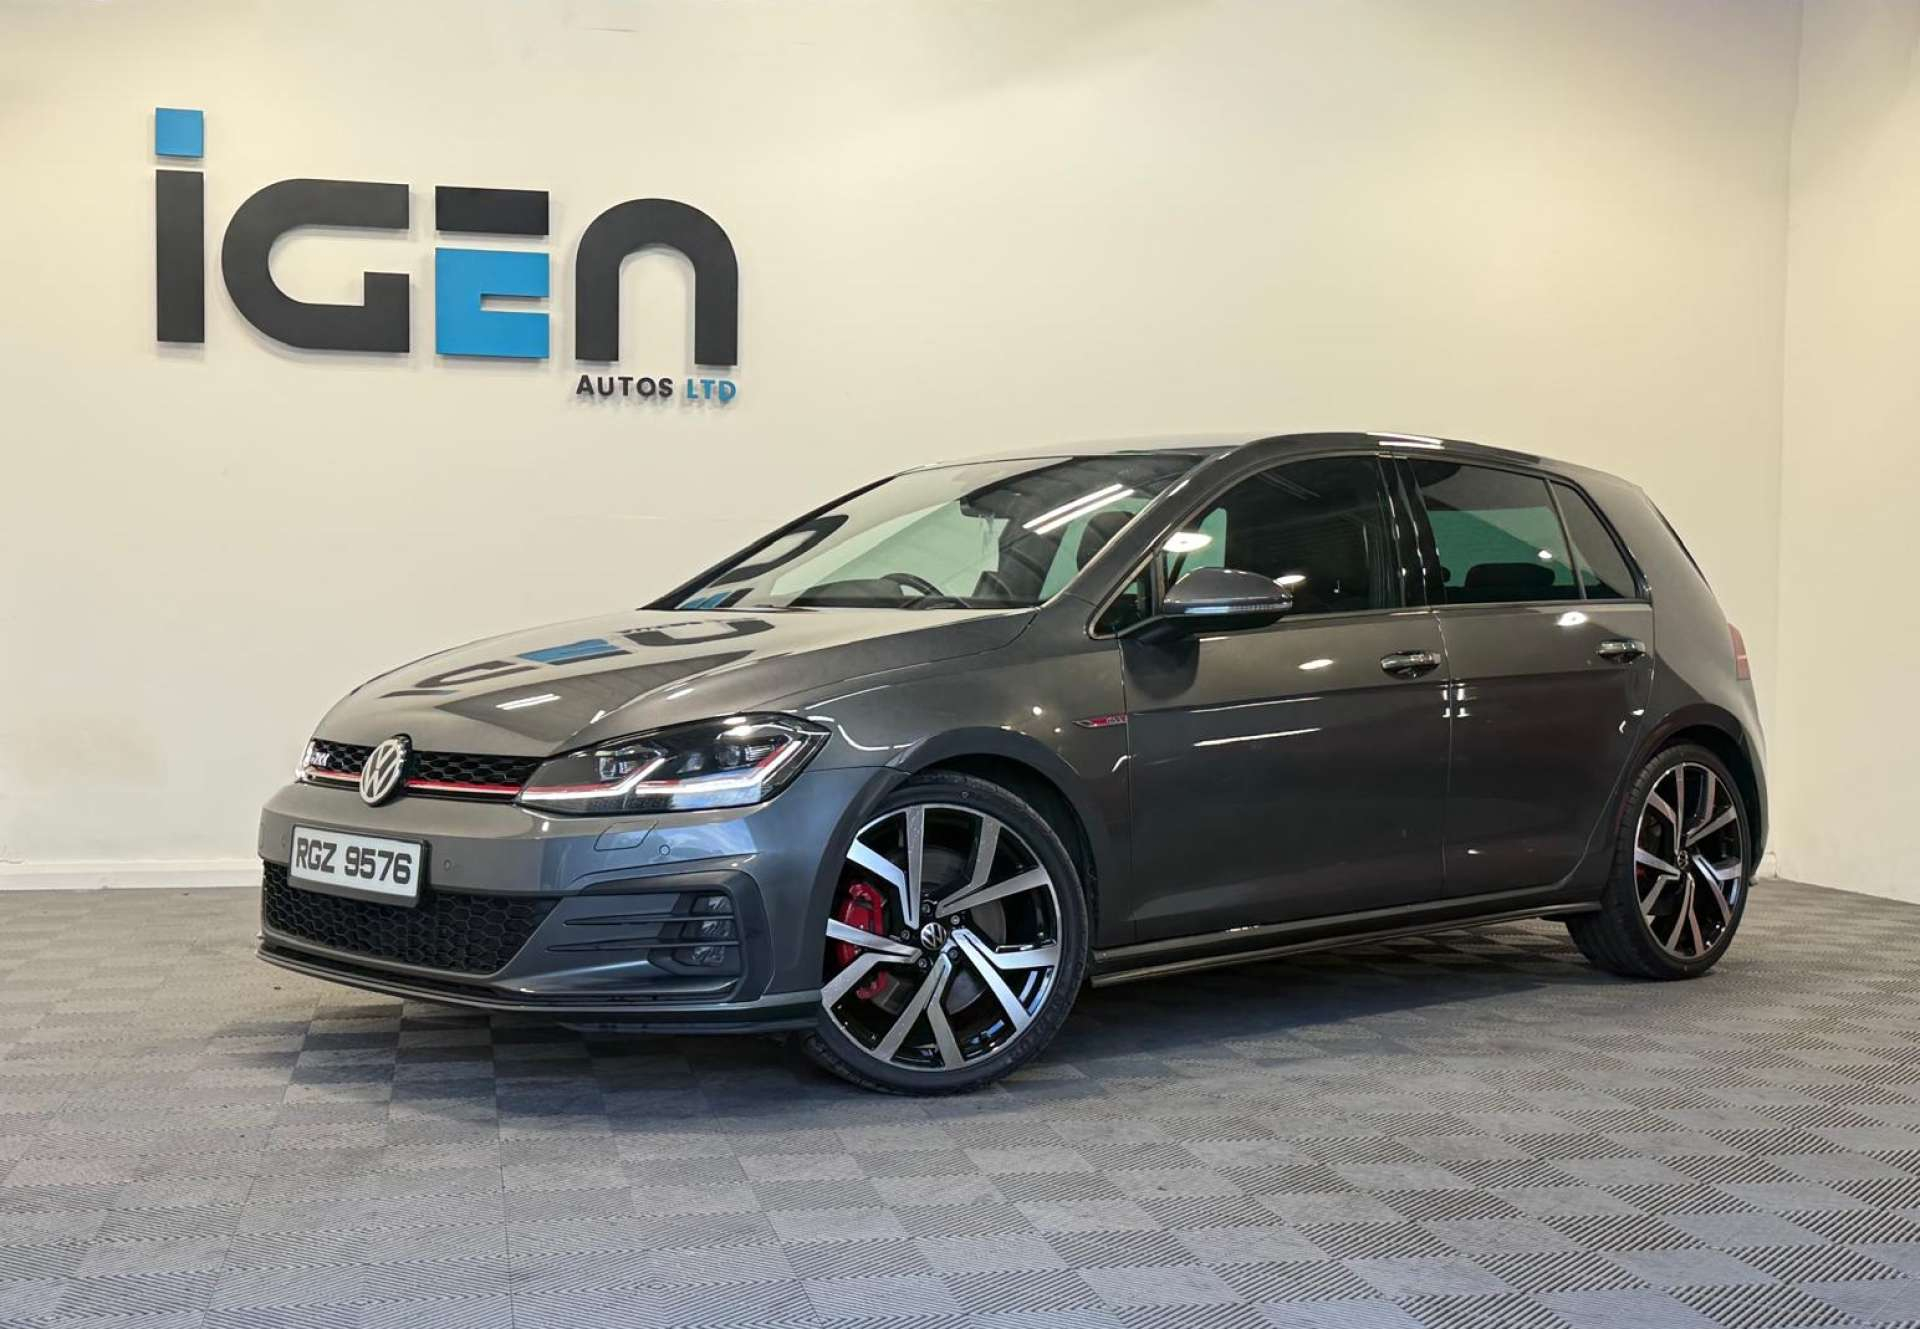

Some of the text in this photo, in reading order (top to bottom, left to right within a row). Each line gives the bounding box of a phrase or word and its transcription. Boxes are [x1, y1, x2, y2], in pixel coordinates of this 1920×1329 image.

[576, 375, 737, 402] AUTOS LTD
[295, 837, 412, 885] RGZ 9576
